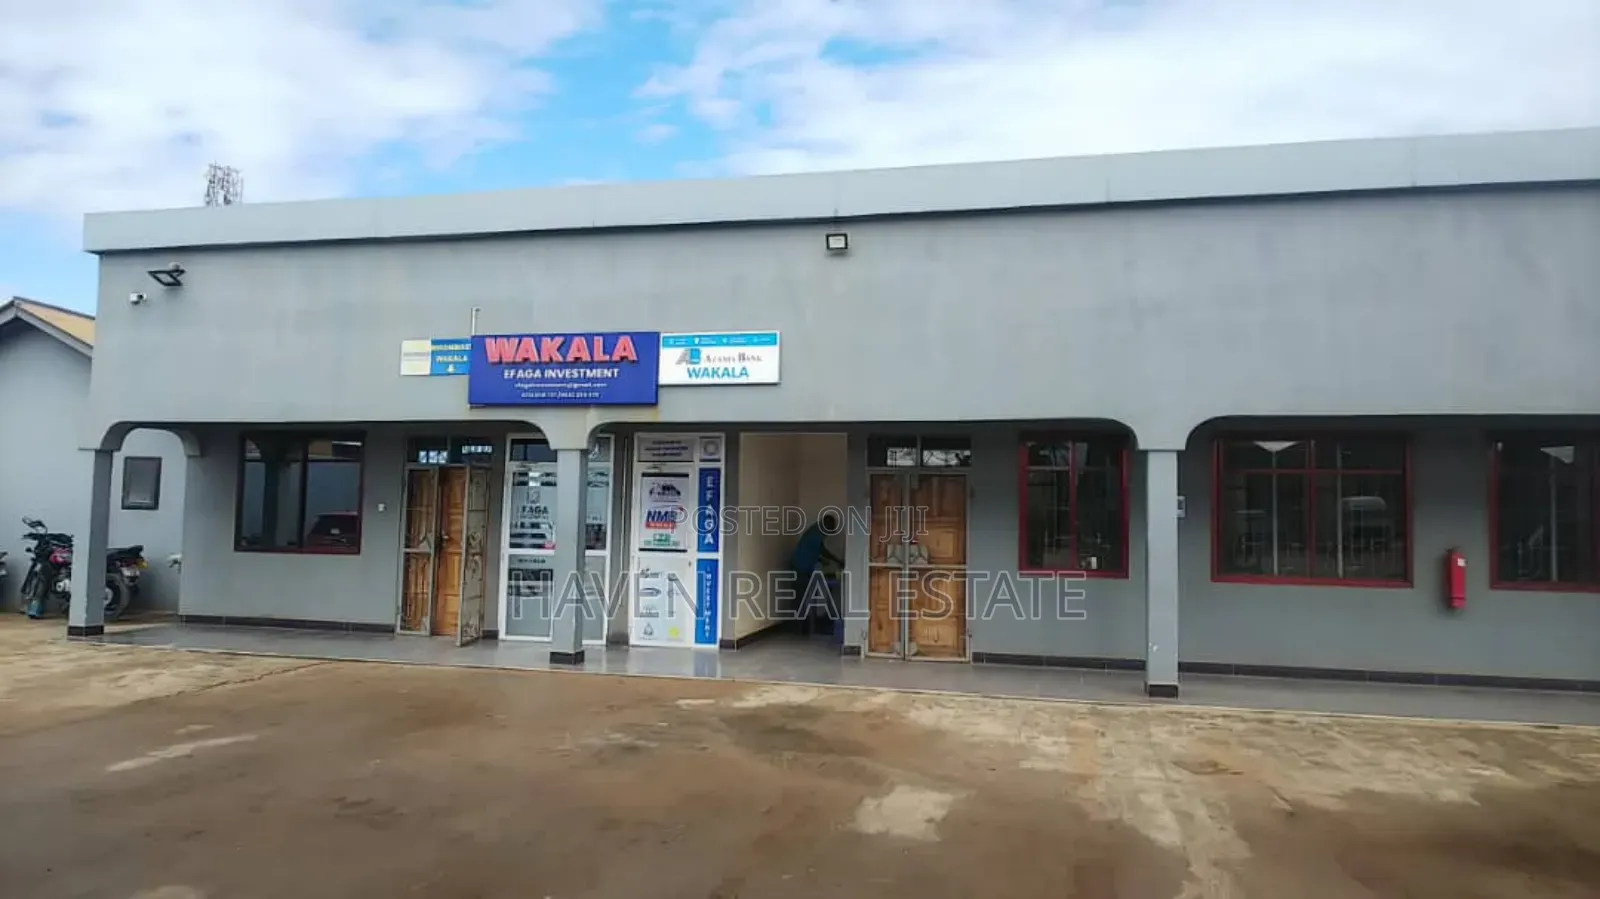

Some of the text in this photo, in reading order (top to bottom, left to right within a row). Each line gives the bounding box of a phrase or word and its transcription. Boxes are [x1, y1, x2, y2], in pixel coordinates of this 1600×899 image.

[485, 335, 638, 364] WAKALA
[503, 367, 620, 379] EFAGA INVESTMENT
[687, 366, 749, 379] WAKALA
[704, 476, 715, 545] EFAGA
